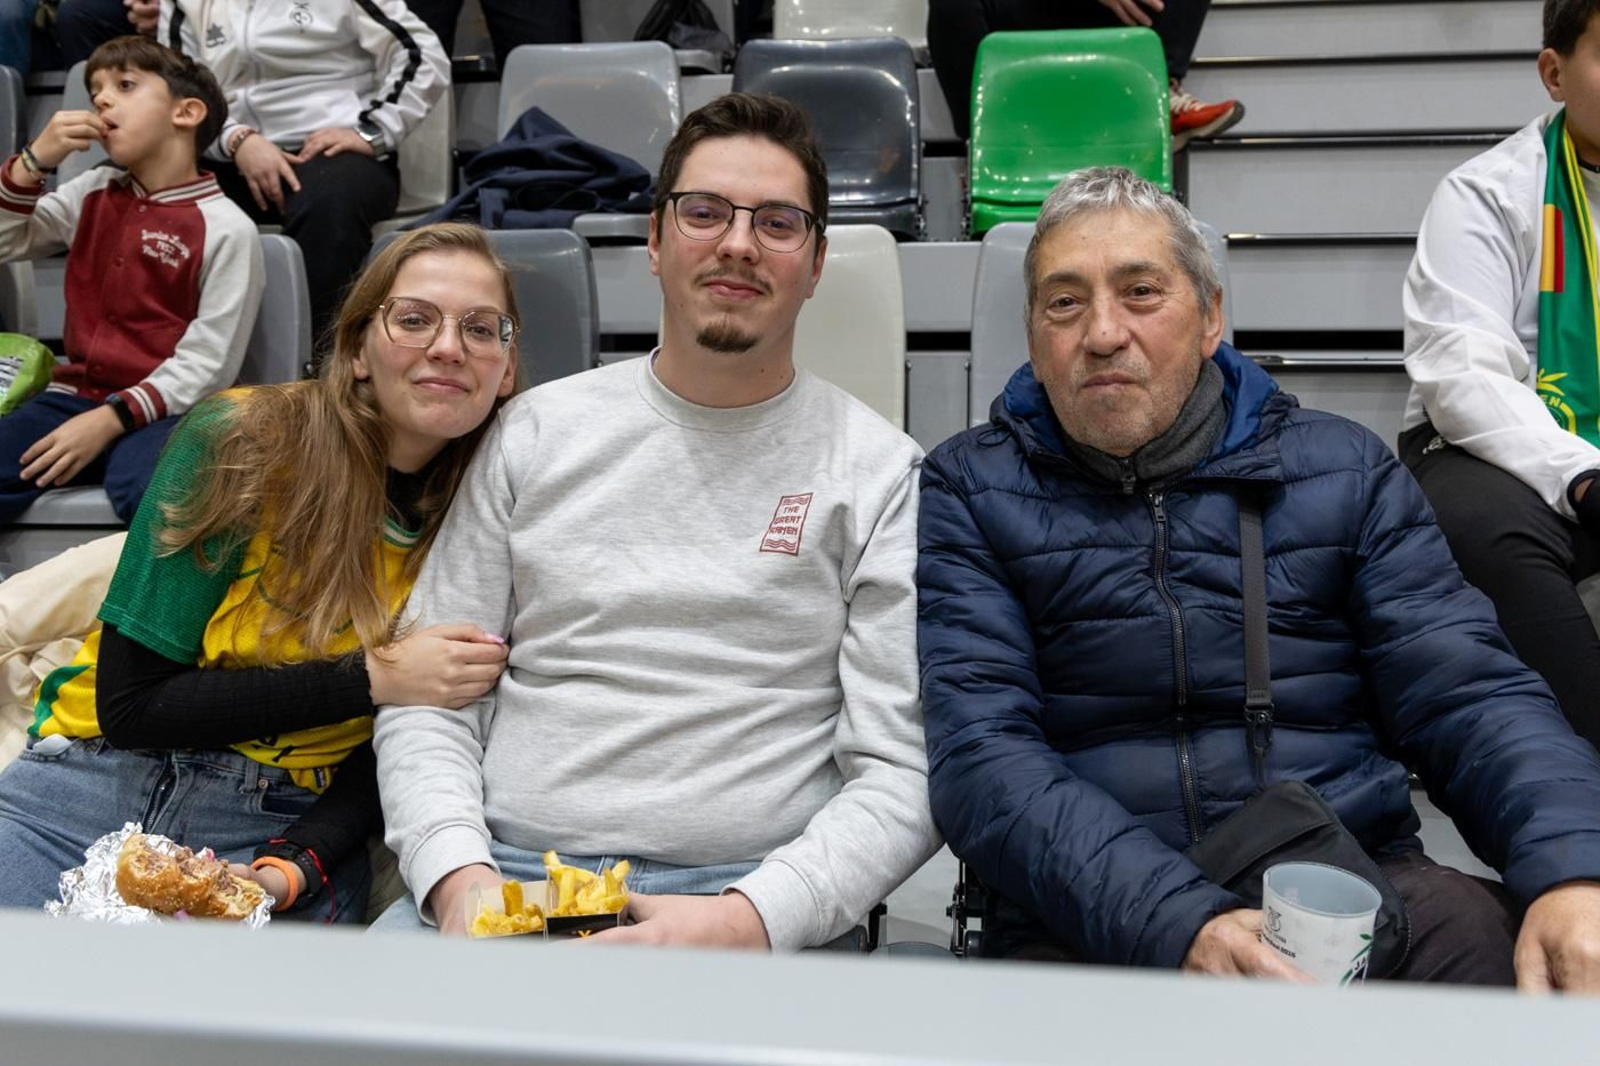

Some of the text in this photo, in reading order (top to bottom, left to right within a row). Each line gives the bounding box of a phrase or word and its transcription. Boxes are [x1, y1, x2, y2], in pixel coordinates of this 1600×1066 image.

[783, 505, 801, 514] THE
[774, 515, 802, 525] GREAT
[769, 526, 799, 535] RAMEN
